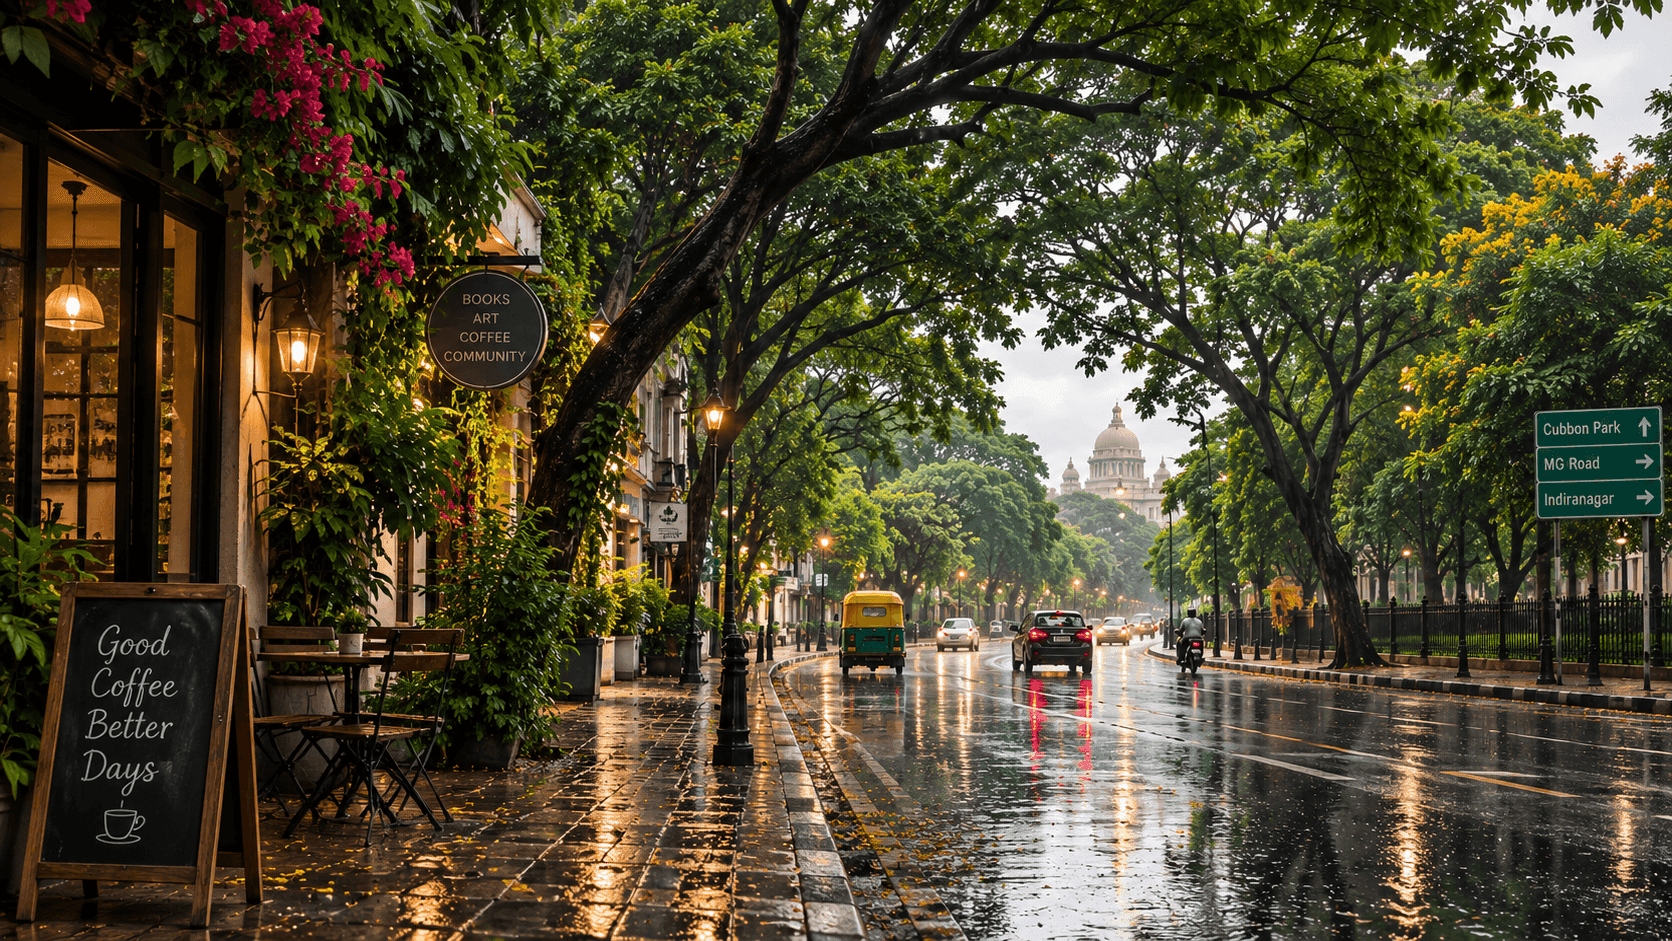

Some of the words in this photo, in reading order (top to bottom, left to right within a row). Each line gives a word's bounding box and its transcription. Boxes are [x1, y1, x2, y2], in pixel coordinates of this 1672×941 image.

[462, 293, 510, 305] BOOKS
[472, 312, 500, 324] ART
[459, 331, 511, 343] COFFEE
[443, 350, 526, 362] COMMUNITY
[1543, 422, 1589, 436] Cubbon
[1593, 420, 1621, 434] Park
[1544, 457, 1565, 471] MG
[1569, 456, 1600, 470] Road
[1544, 492, 1614, 508] Indiranagar
[97, 624, 172, 665] Good
[91, 667, 178, 708] Coffee
[85, 708, 173, 740] Better
[80, 749, 160, 797] Days
